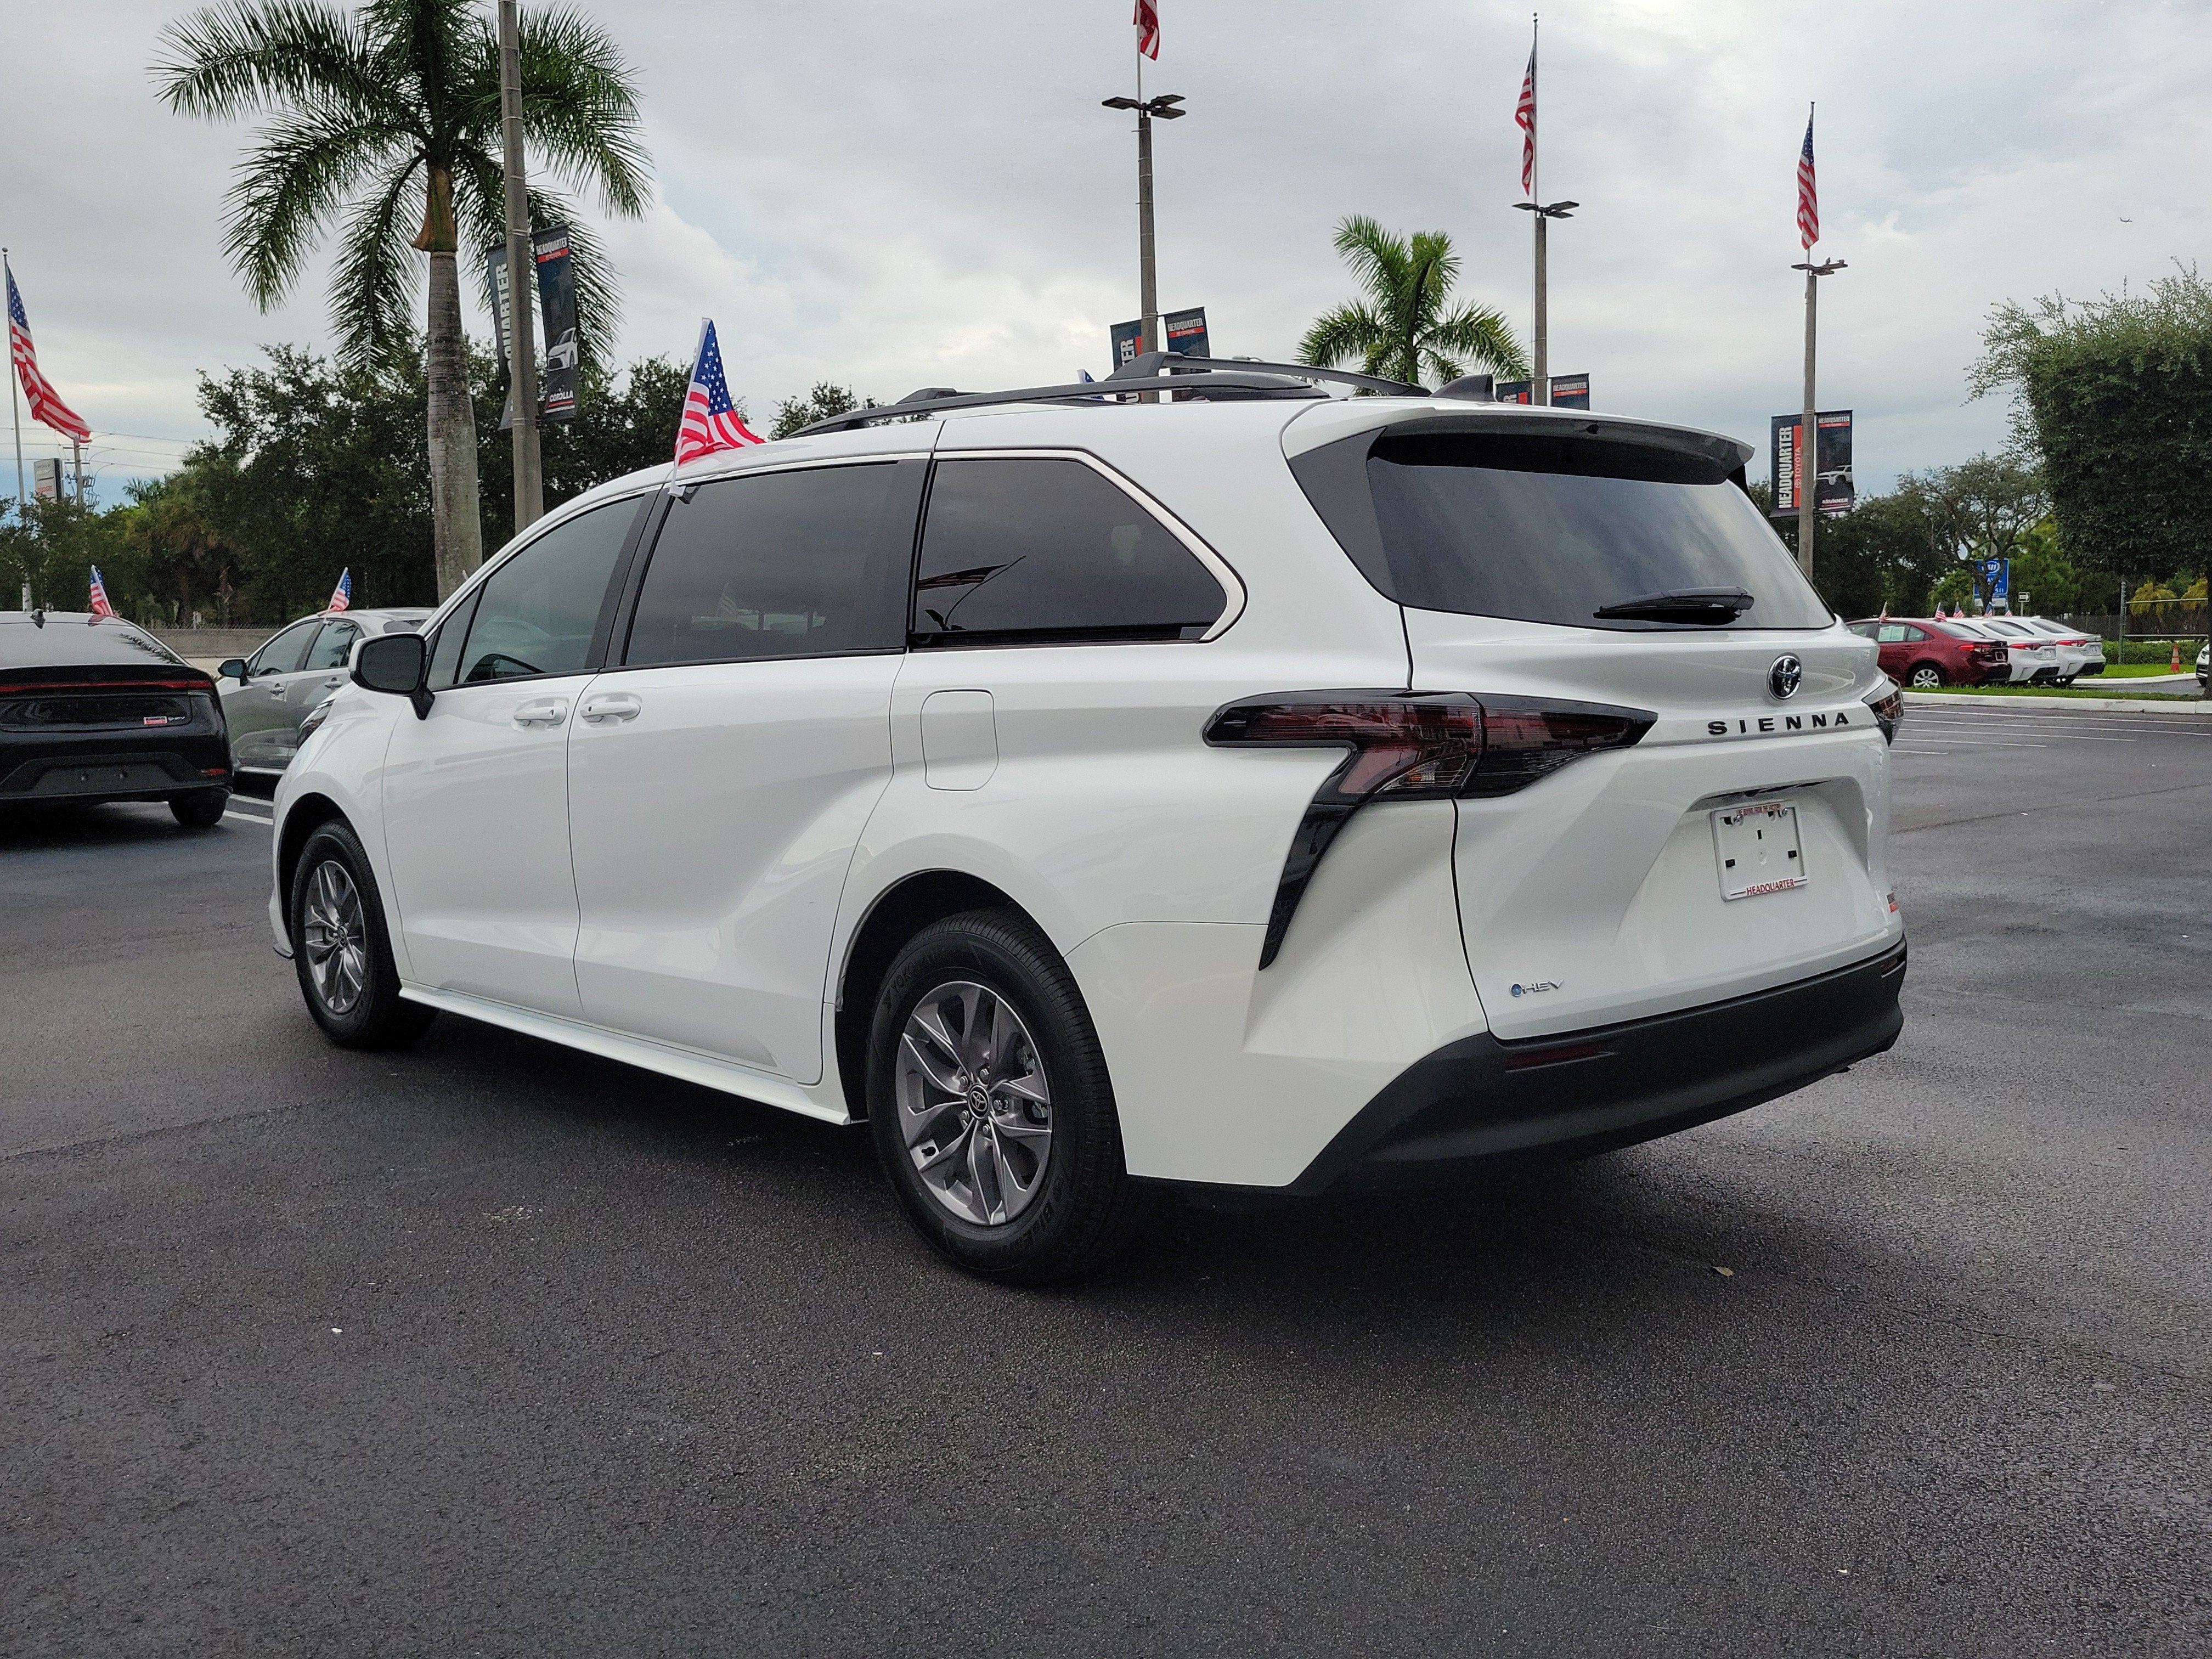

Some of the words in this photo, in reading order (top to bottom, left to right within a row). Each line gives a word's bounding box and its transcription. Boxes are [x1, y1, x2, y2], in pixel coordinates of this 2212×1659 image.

[1778, 426, 1793, 509] HEADQUARTER
[1707, 712, 1849, 735] SIENNA
[1746, 878, 1795, 895] HEADQUARTER
